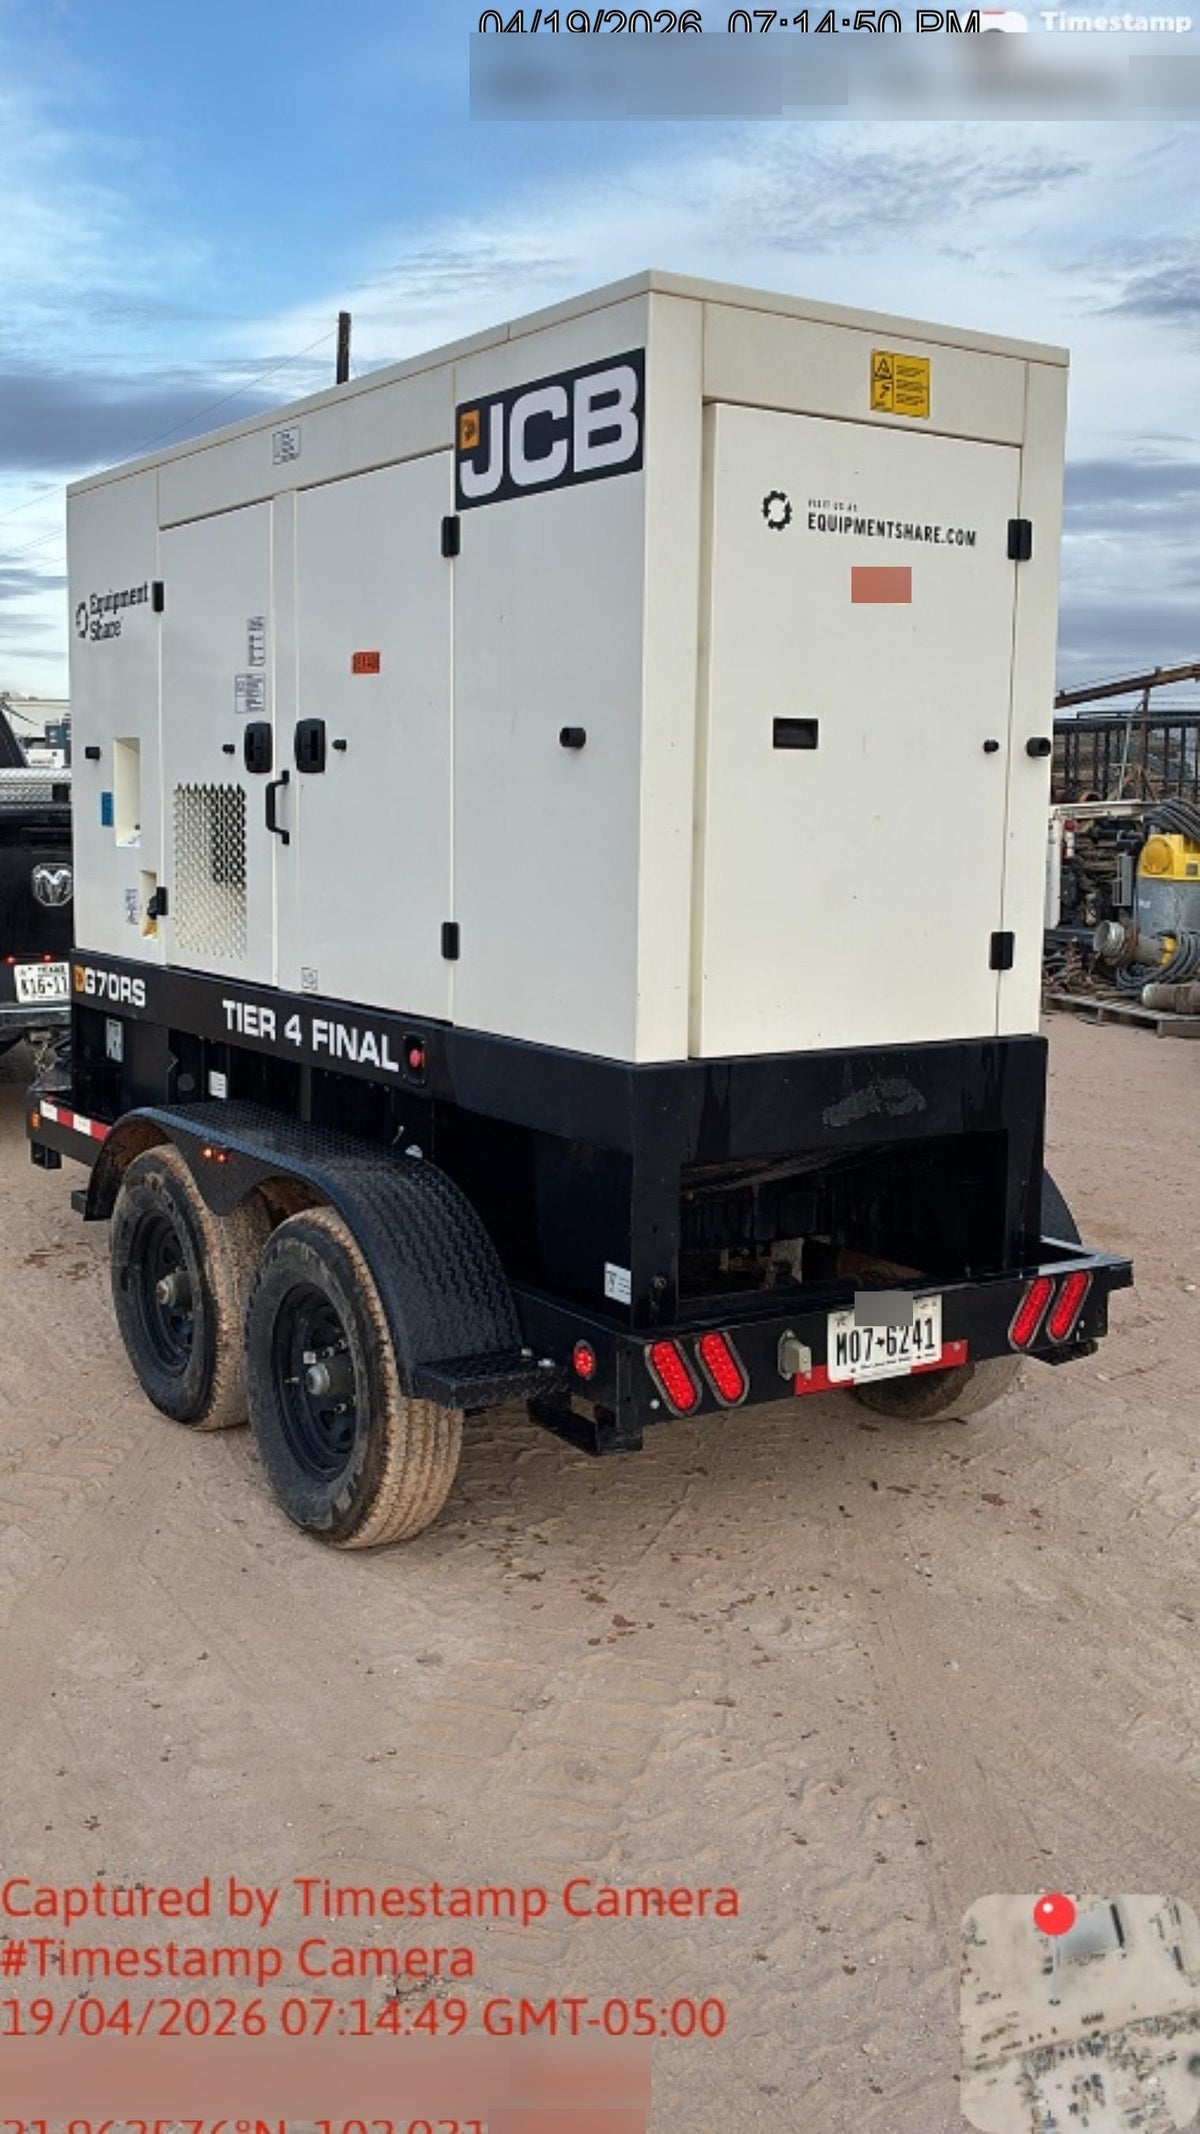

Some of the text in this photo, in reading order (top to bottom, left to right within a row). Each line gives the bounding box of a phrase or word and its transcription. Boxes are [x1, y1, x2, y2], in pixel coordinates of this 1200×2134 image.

[459, 365, 639, 498] JCB
[808, 511, 976, 547] EQUIPMENTSHARE.COM
[89, 581, 148, 619] Equipment
[89, 619, 122, 641] Share
[222, 998, 400, 1073] TIER 4 FINAL
